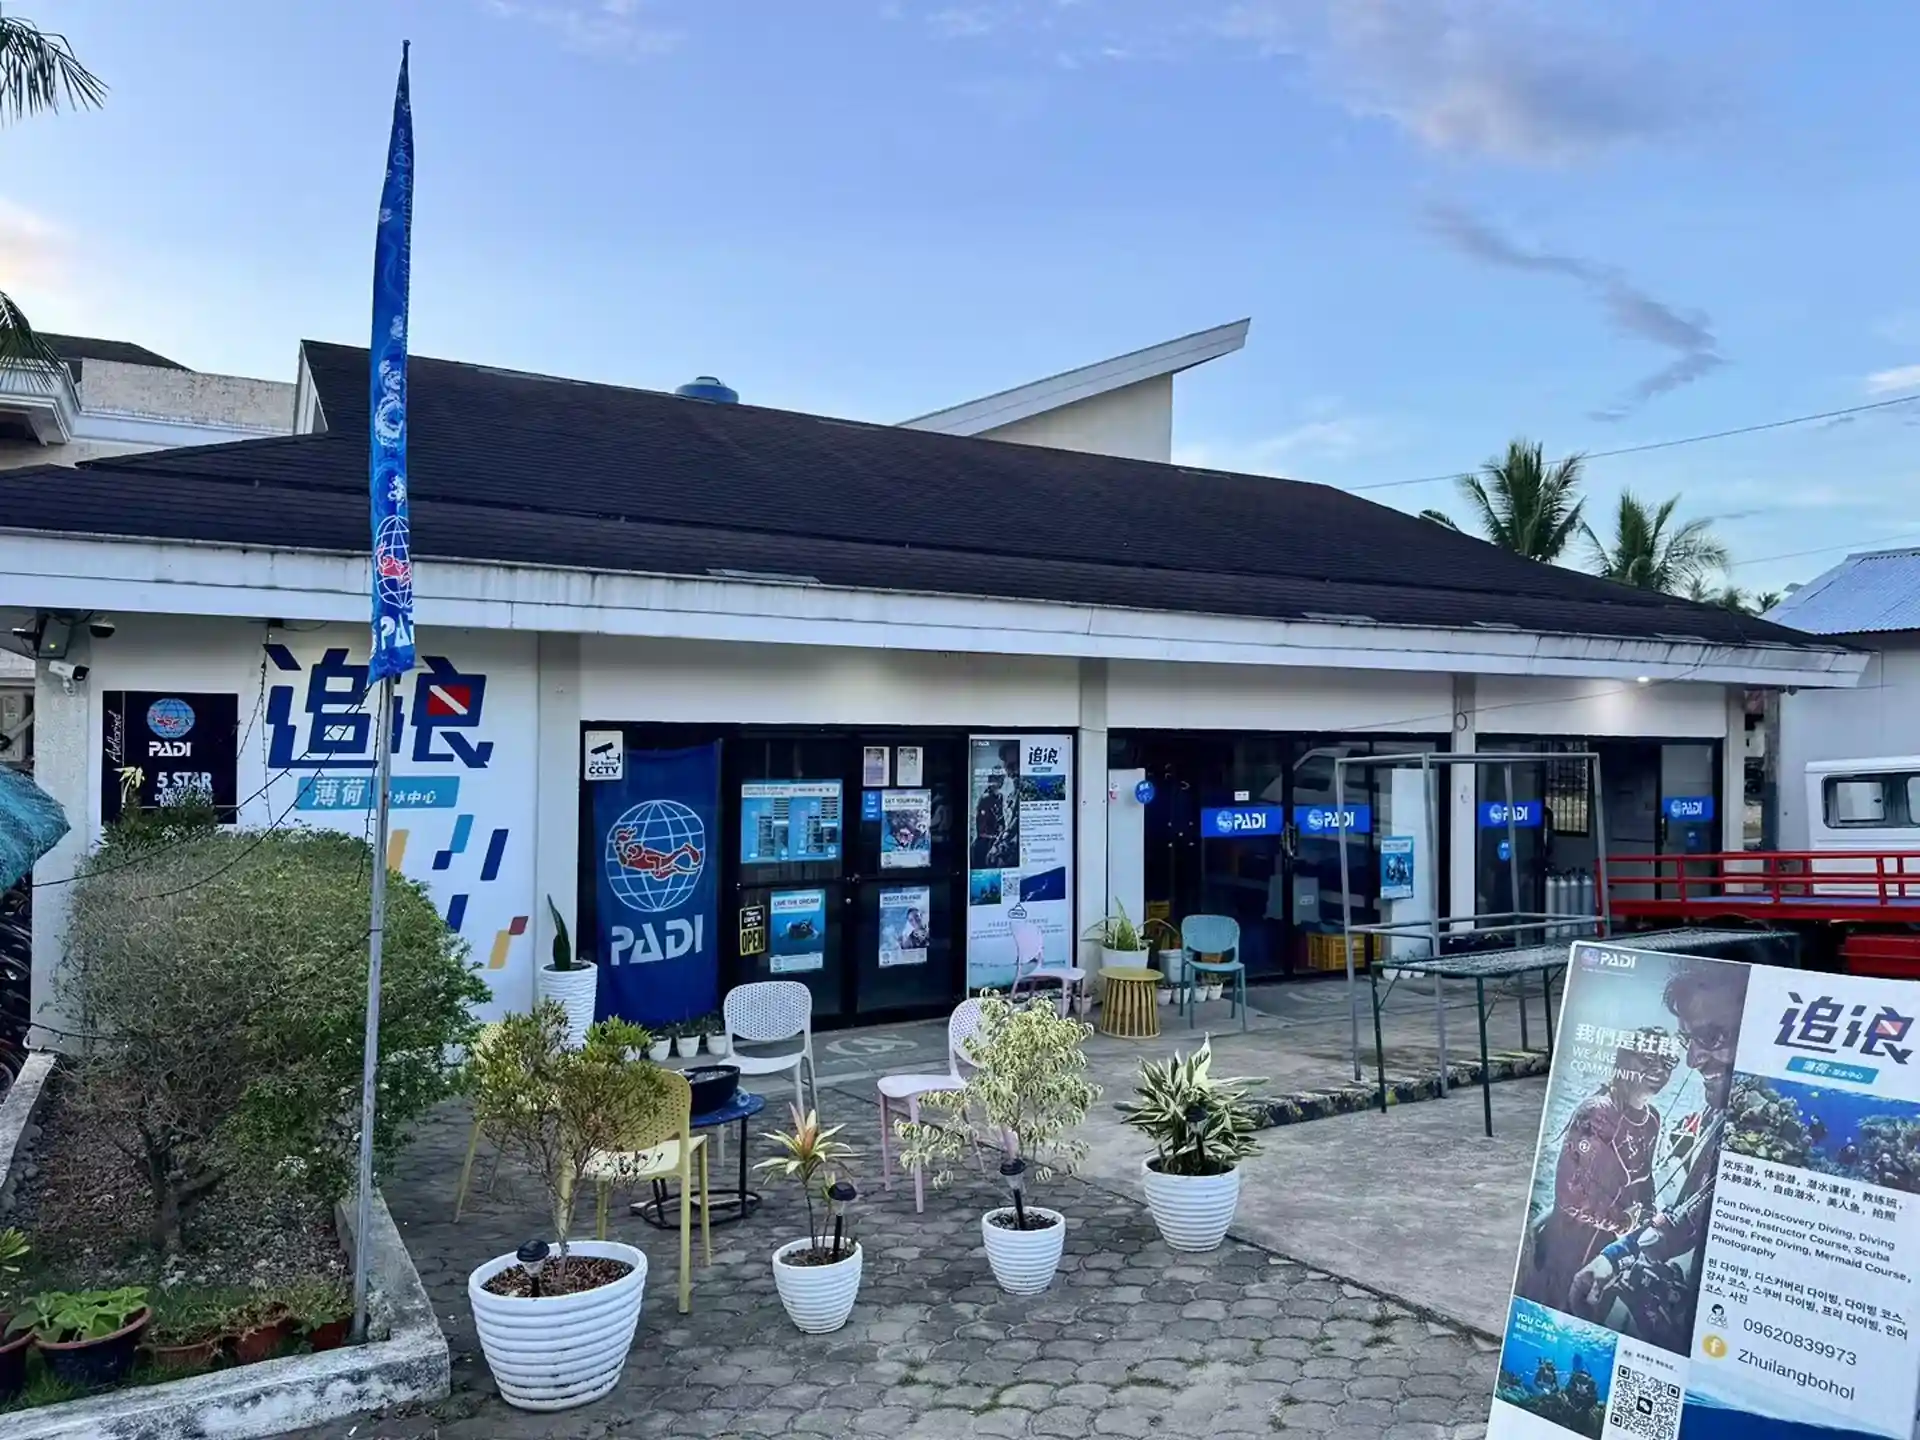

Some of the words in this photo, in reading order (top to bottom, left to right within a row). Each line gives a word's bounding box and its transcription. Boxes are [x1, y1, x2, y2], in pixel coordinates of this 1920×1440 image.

[380, 615, 415, 651] PA
[263, 644, 494, 768] 追浪
[148, 741, 192, 757] PADI
[1028, 746, 1059, 765] 追浪
[156, 771, 169, 788] 5
[172, 771, 212, 789] STAR
[588, 766, 619, 774] CCTV
[1682, 801, 1703, 815] PADI
[1233, 812, 1267, 830] PADI
[610, 914, 704, 966] PADI
[741, 930, 764, 954] OPEN
[1600, 951, 1636, 969] PADI
[1773, 991, 1915, 1065] 追浪
[1572, 1044, 1591, 1059] WE
[1594, 1049, 1617, 1064] ARE
[1570, 1059, 1646, 1083] COMMUNITY
[1716, 1196, 1737, 1208] Fun
[1859, 1232, 1896, 1251] Diving
[1711, 1234, 1777, 1260] Photography
[1756, 1220, 1806, 1240] Instructor
[1854, 1246, 1890, 1262] Scuba
[1750, 1231, 1773, 1244] Free
[1815, 1249, 1862, 1269] Mermaid
[1865, 1262, 1912, 1283] Course,
[1516, 1311, 1533, 1325] YOU
[1743, 1318, 1857, 1367] 09620839973
[1737, 1348, 1856, 1401] Zhuilangbohol
